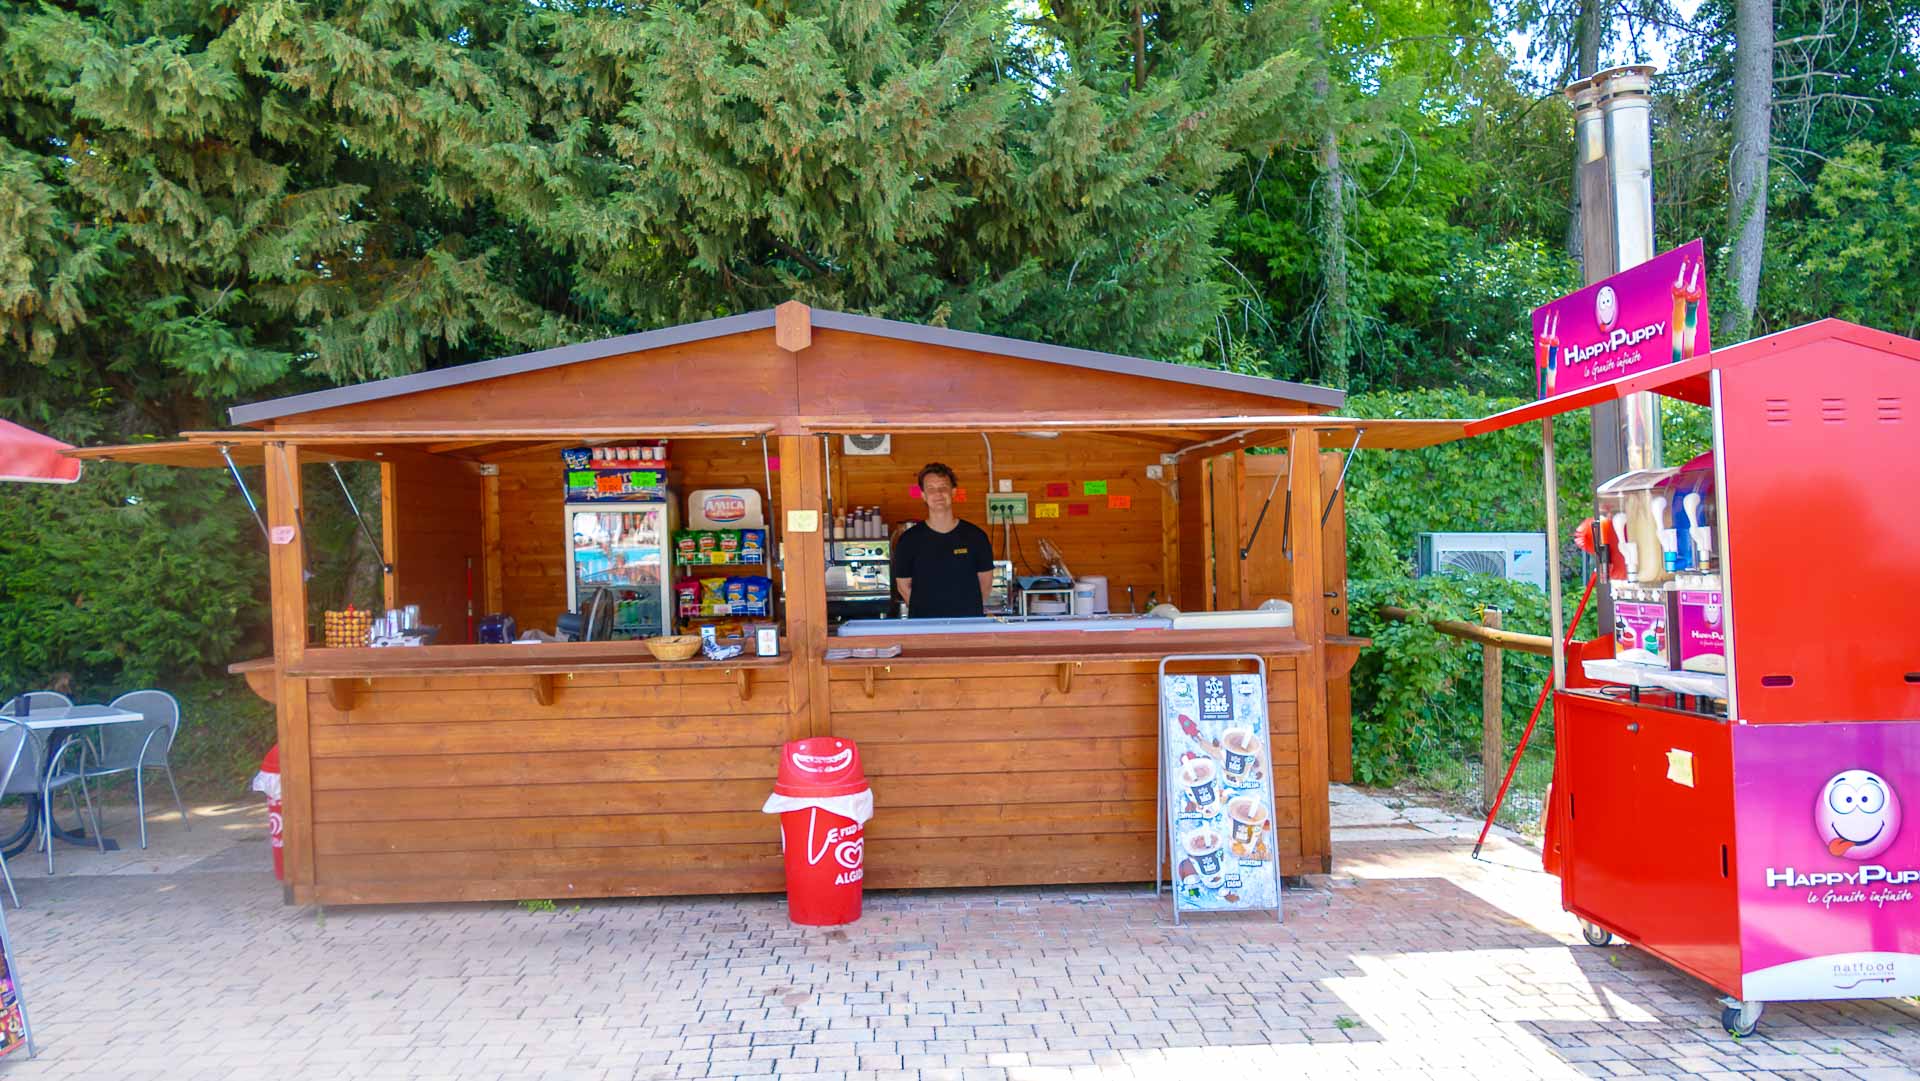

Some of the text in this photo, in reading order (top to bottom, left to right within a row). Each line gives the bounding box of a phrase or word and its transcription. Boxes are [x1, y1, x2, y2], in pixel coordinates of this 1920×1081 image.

[705, 500, 745, 511] AMICA
[835, 869, 864, 885] ALGID
[1765, 864, 1920, 888] HAPPYPUP
[1821, 888, 1866, 910] Granite
[1869, 887, 1913, 909] infinite
